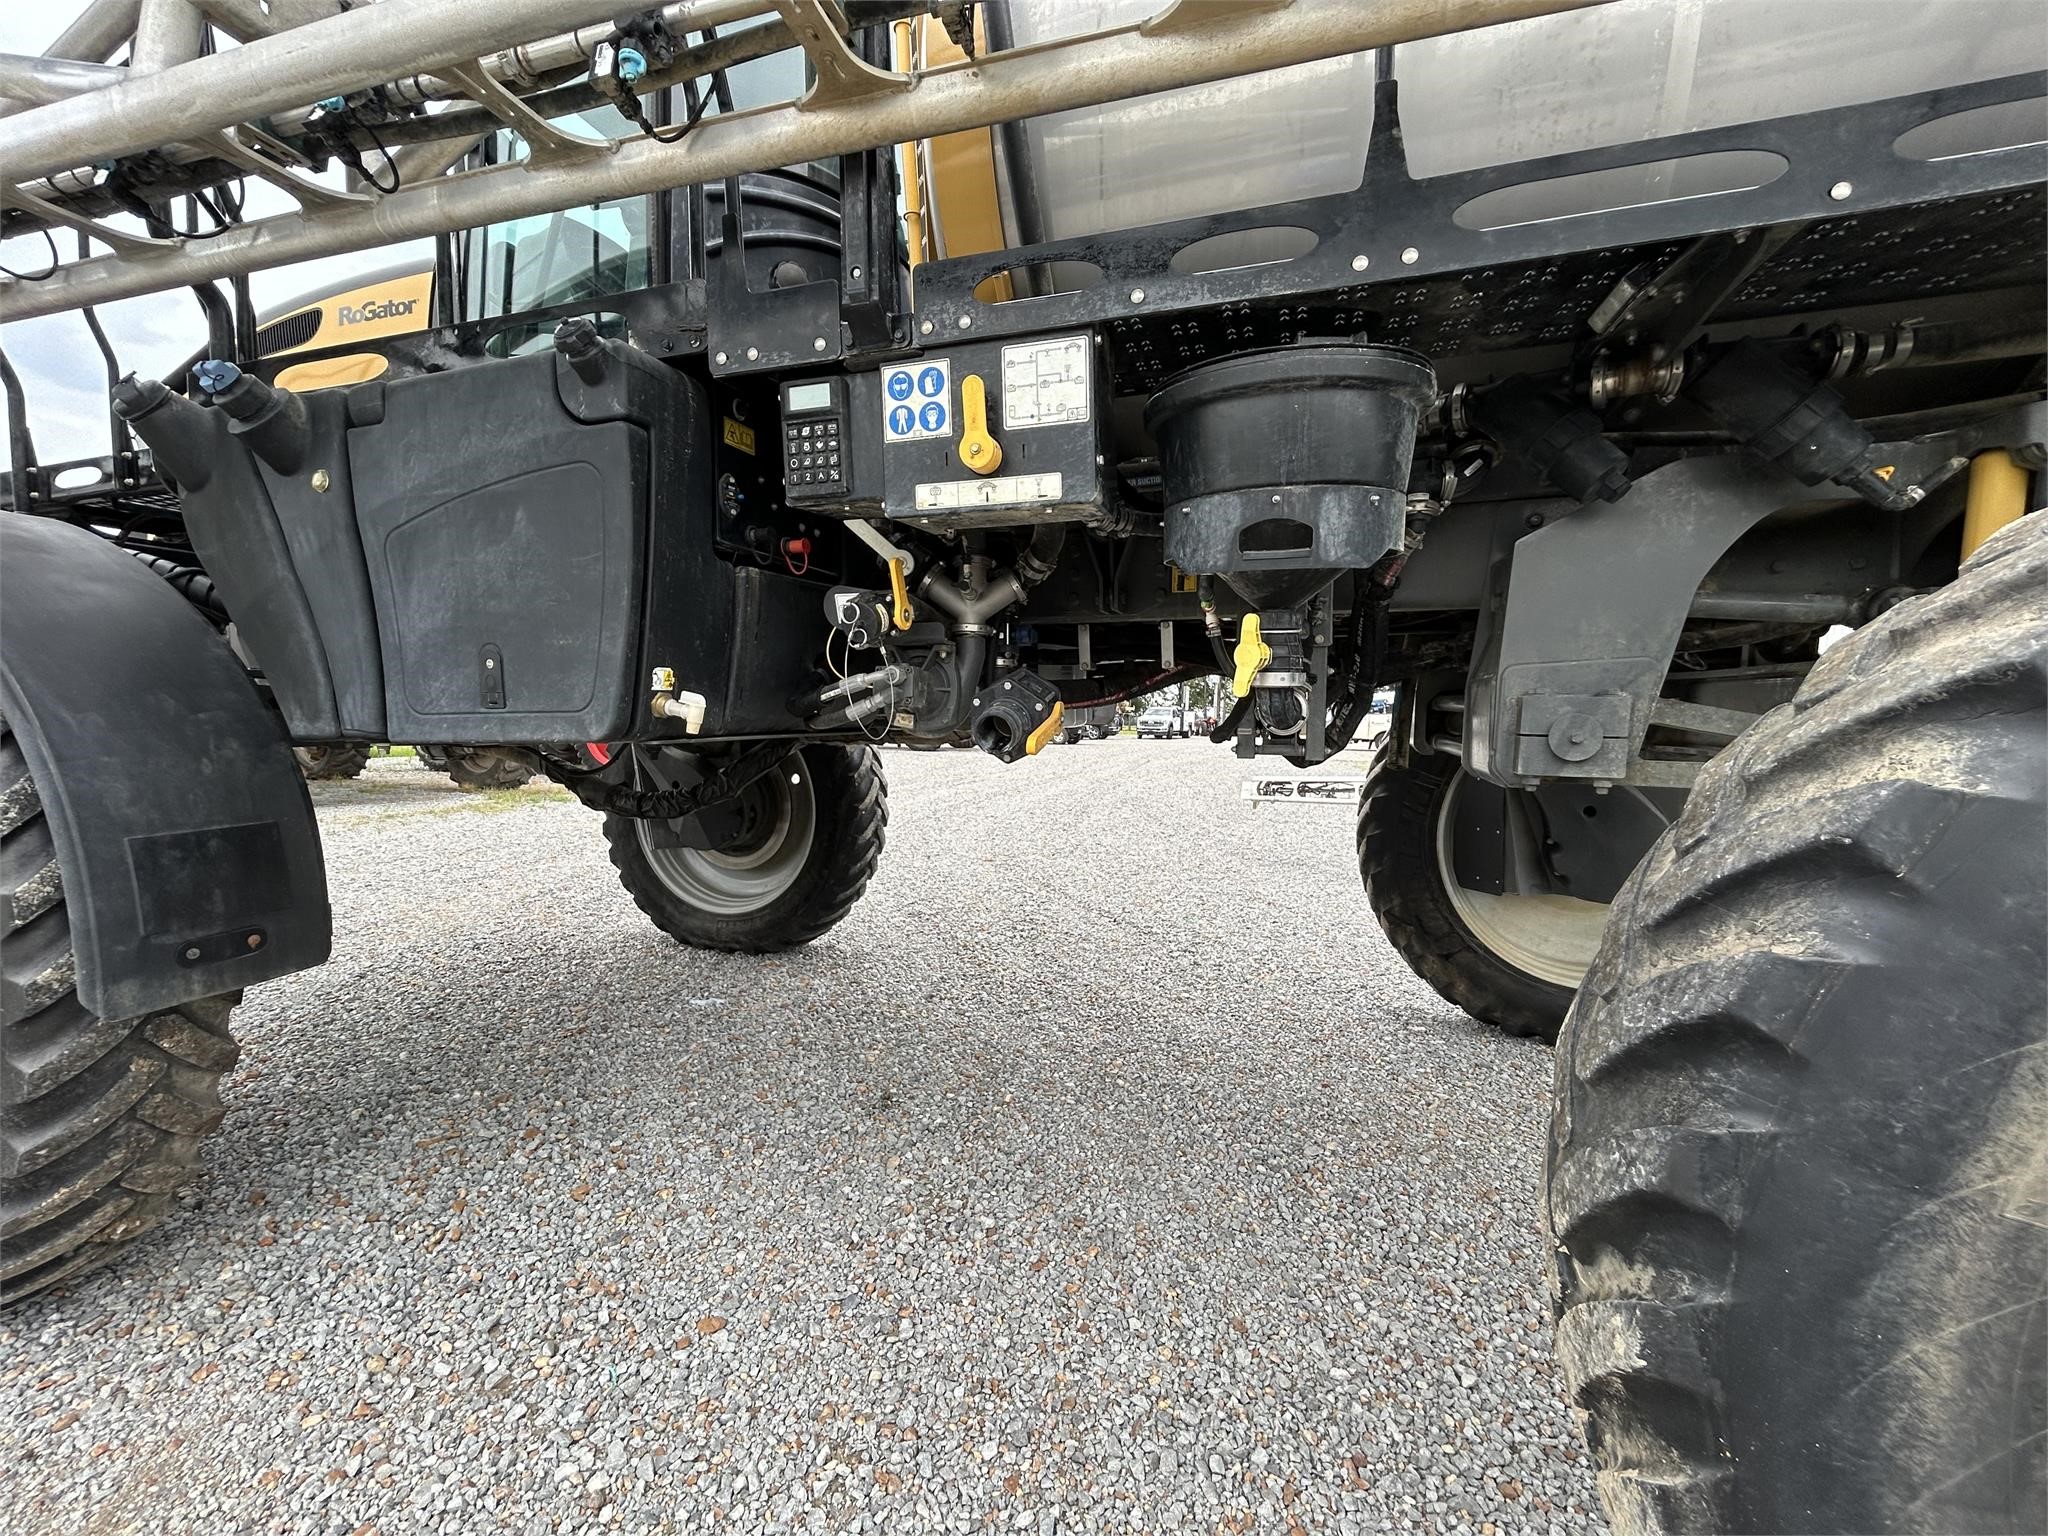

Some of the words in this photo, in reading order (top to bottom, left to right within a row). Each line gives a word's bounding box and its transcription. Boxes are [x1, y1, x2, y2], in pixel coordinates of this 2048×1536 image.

[338, 299, 418, 326] RoGator
[805, 473, 811, 481] 2
[818, 471, 824, 480] A
[1136, 475, 1162, 486] SUCTIO
